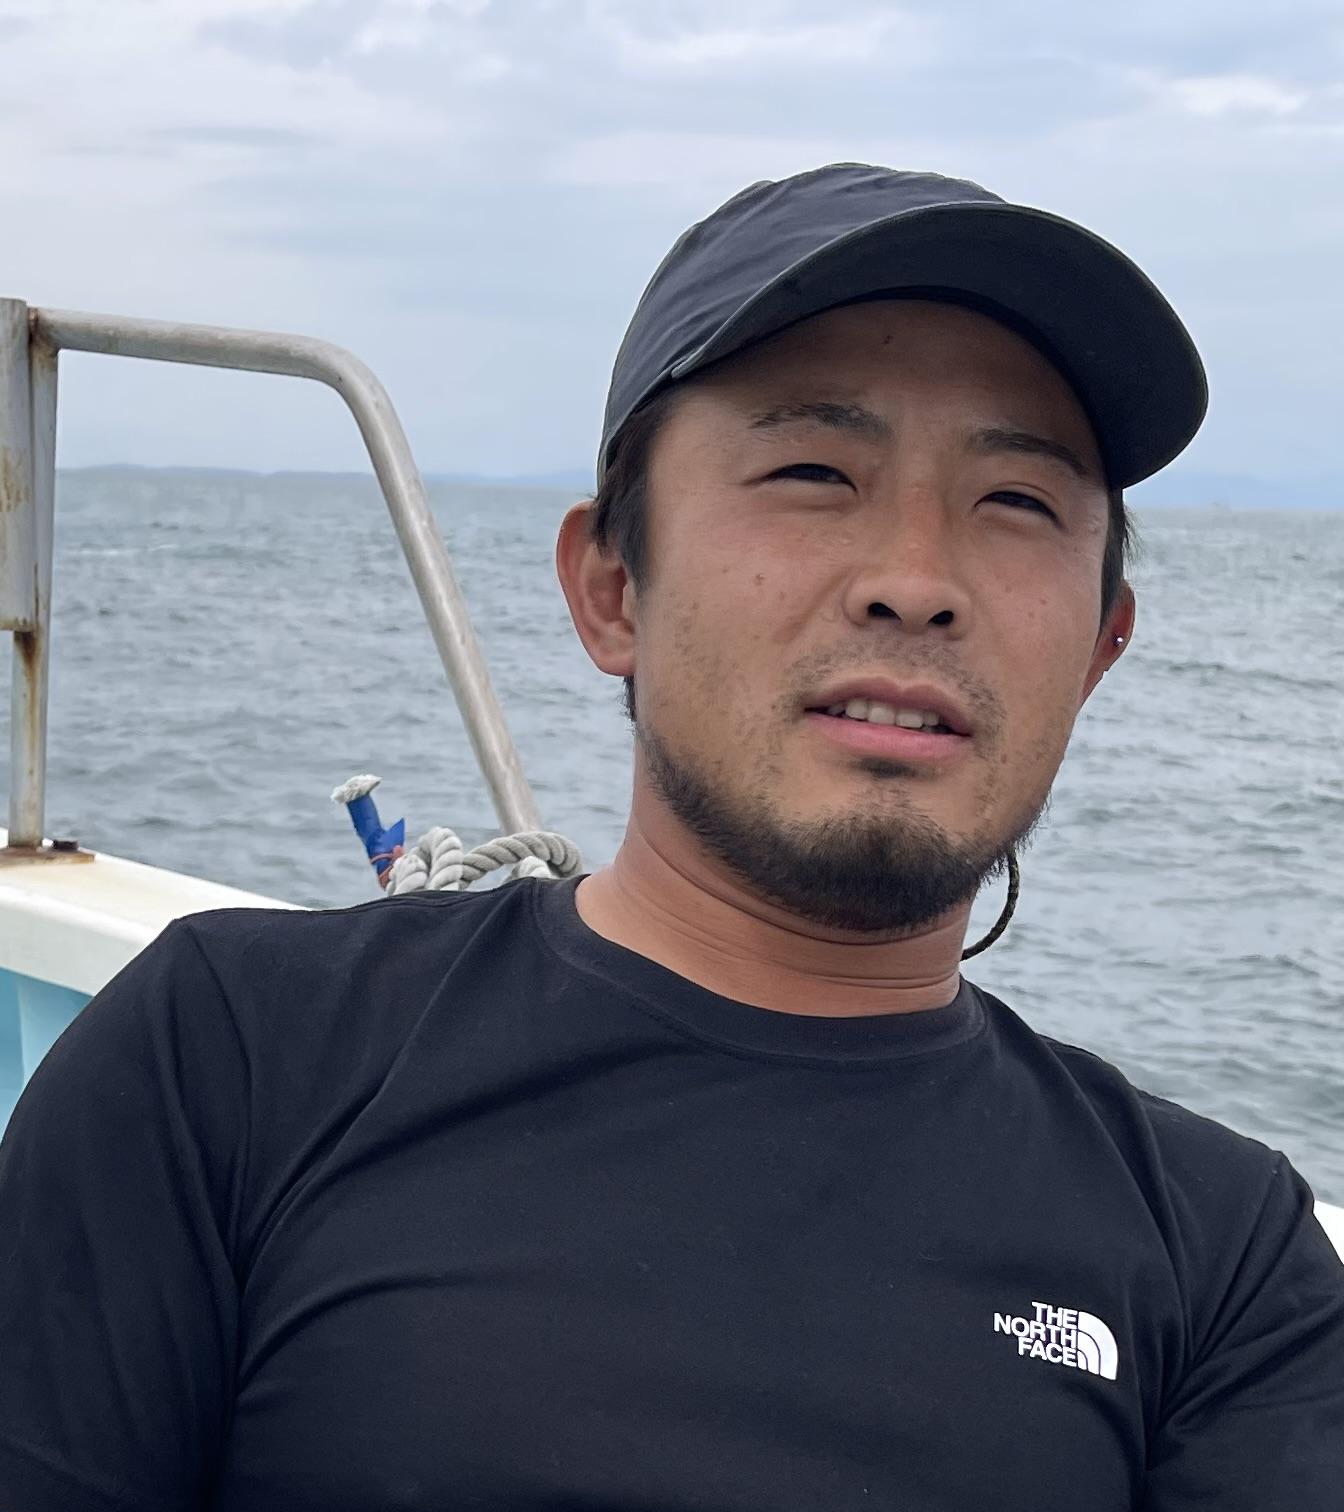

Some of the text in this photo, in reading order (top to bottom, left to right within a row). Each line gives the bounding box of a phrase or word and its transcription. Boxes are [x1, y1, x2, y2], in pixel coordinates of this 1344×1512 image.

[1032, 1302, 1078, 1328] THE
[994, 1312, 1077, 1349] NORTH
[1018, 1337, 1077, 1367] FACE
